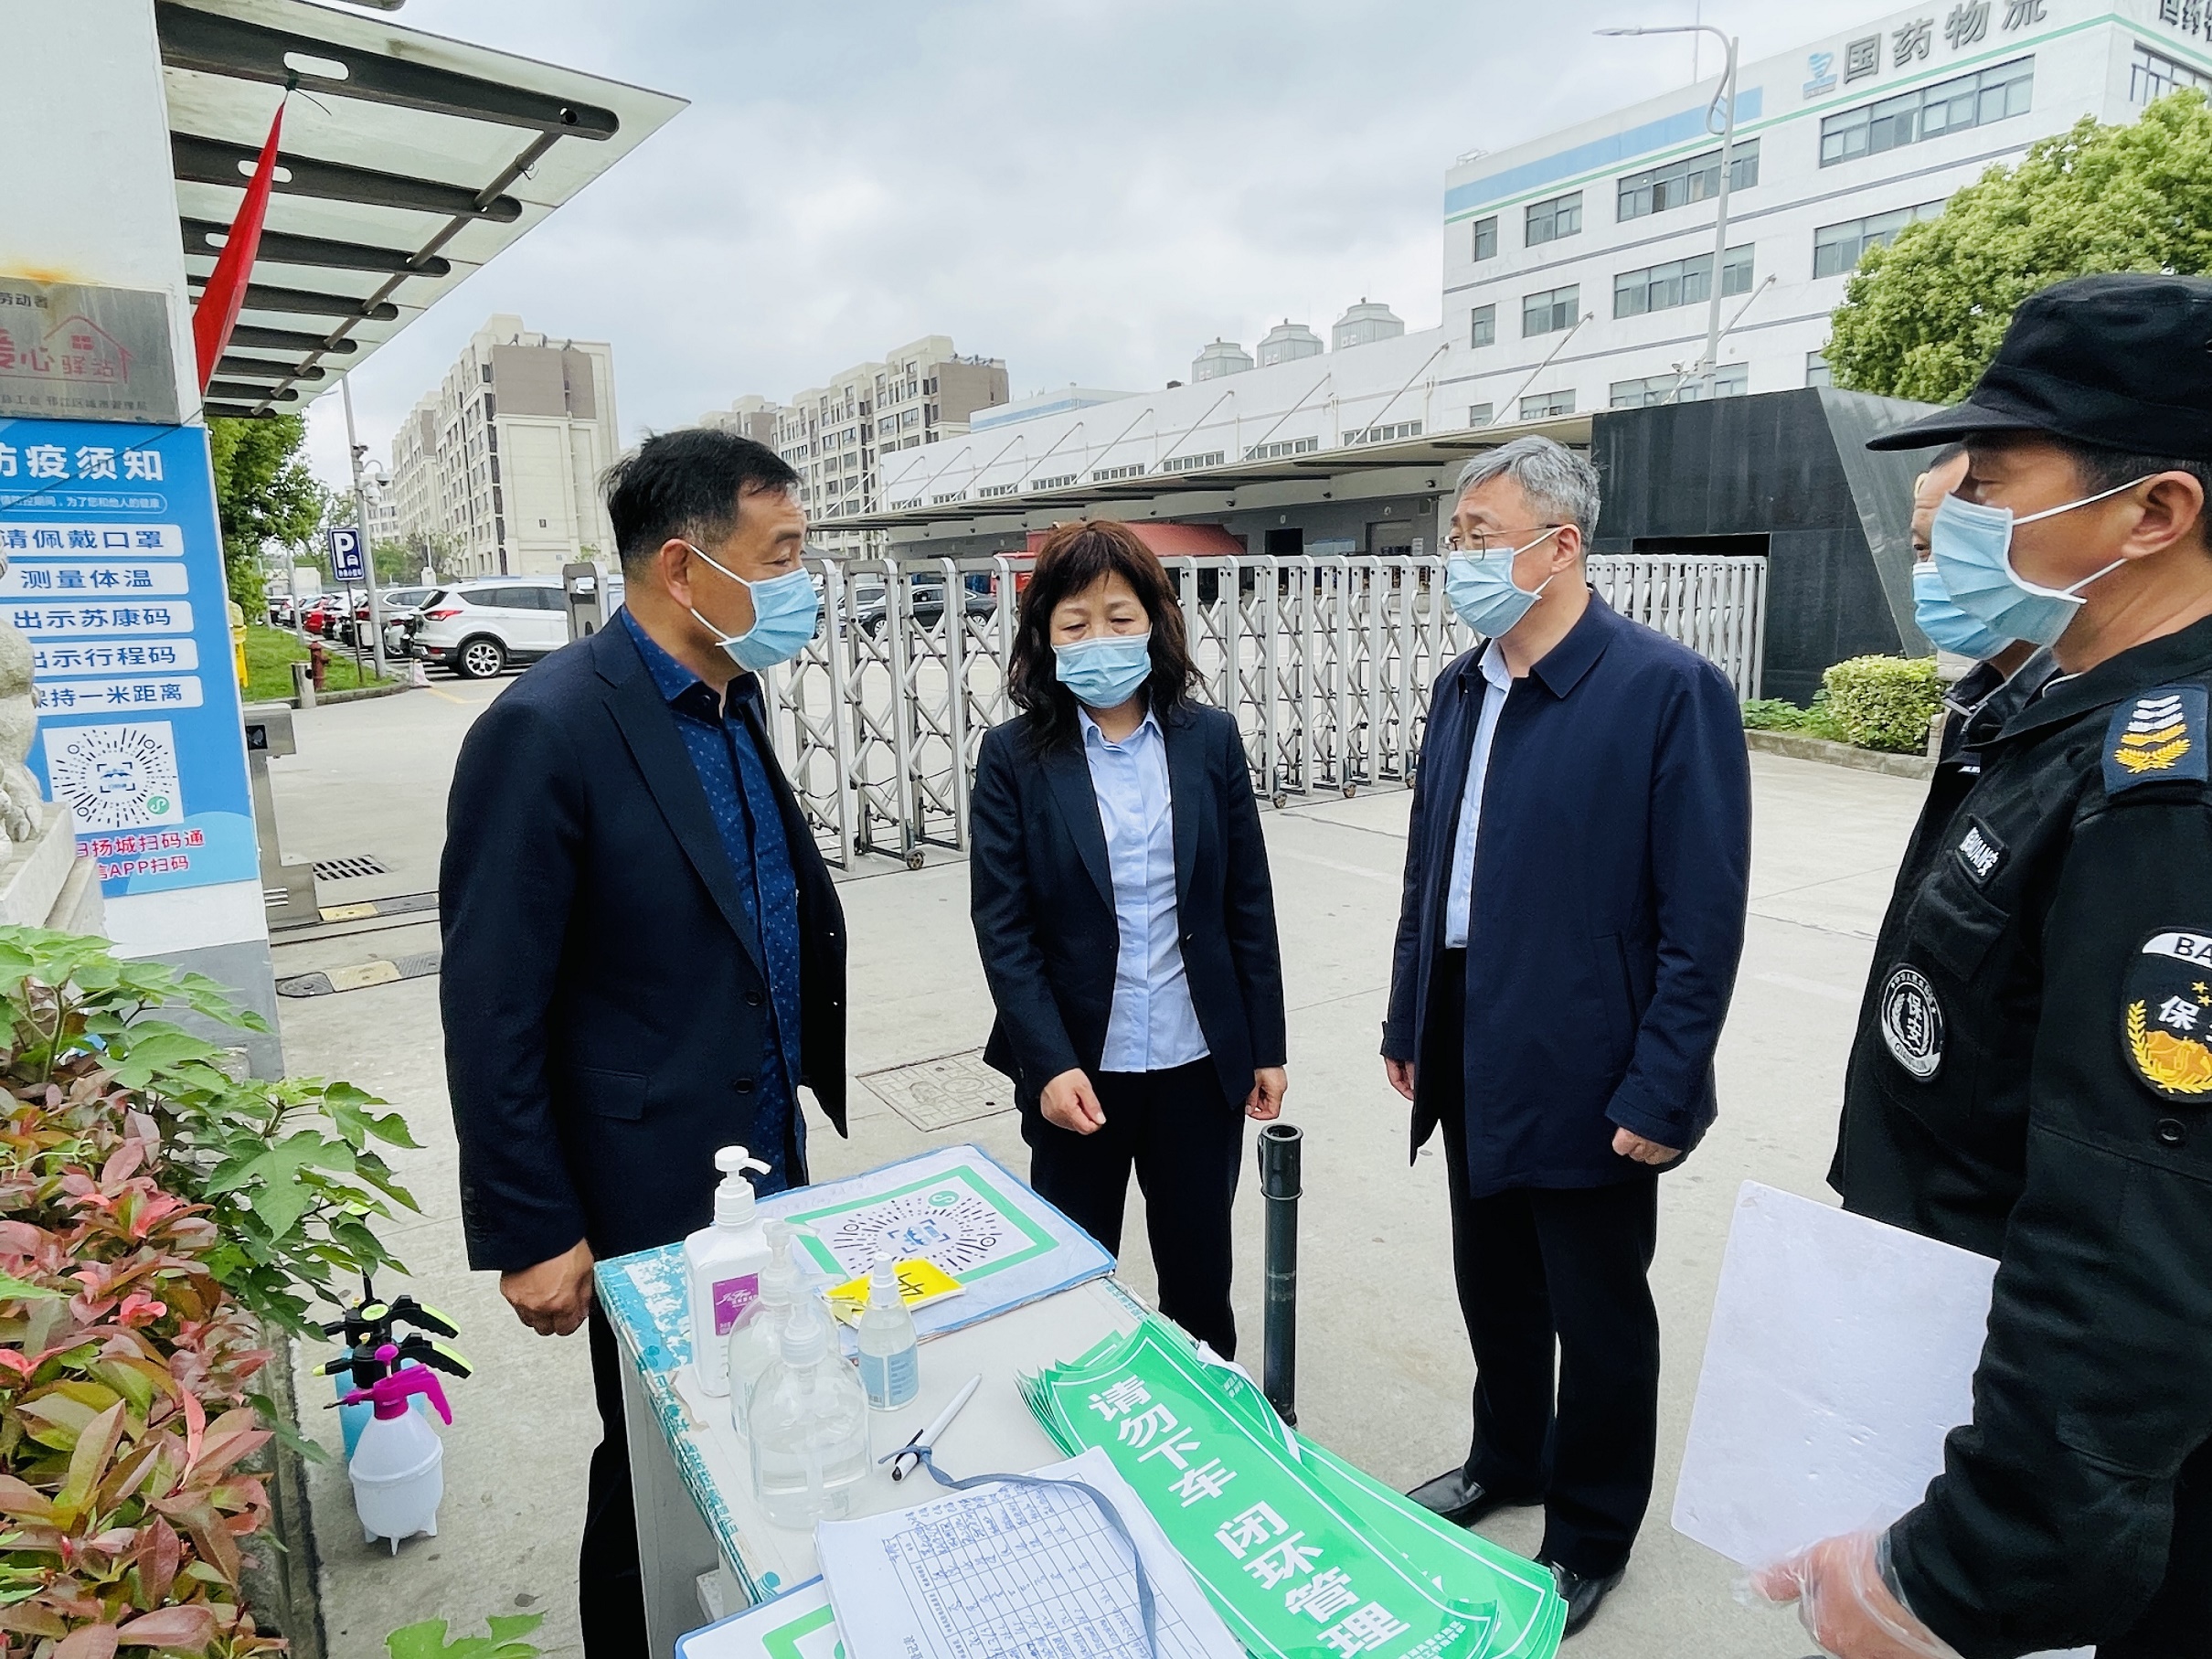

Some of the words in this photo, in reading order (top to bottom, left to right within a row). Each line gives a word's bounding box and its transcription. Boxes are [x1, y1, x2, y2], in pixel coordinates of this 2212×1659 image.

[1844, 0, 2047, 84] 国药物流
[0, 528, 164, 548] 请佩戴口罩
[334, 533, 355, 569] P
[21, 568, 154, 590] 测量体温
[14, 608, 171, 630] 出示苏康码
[1088, 1374, 1238, 1508] 请勿下车
[1214, 1500, 1411, 1658] 闭环管理
